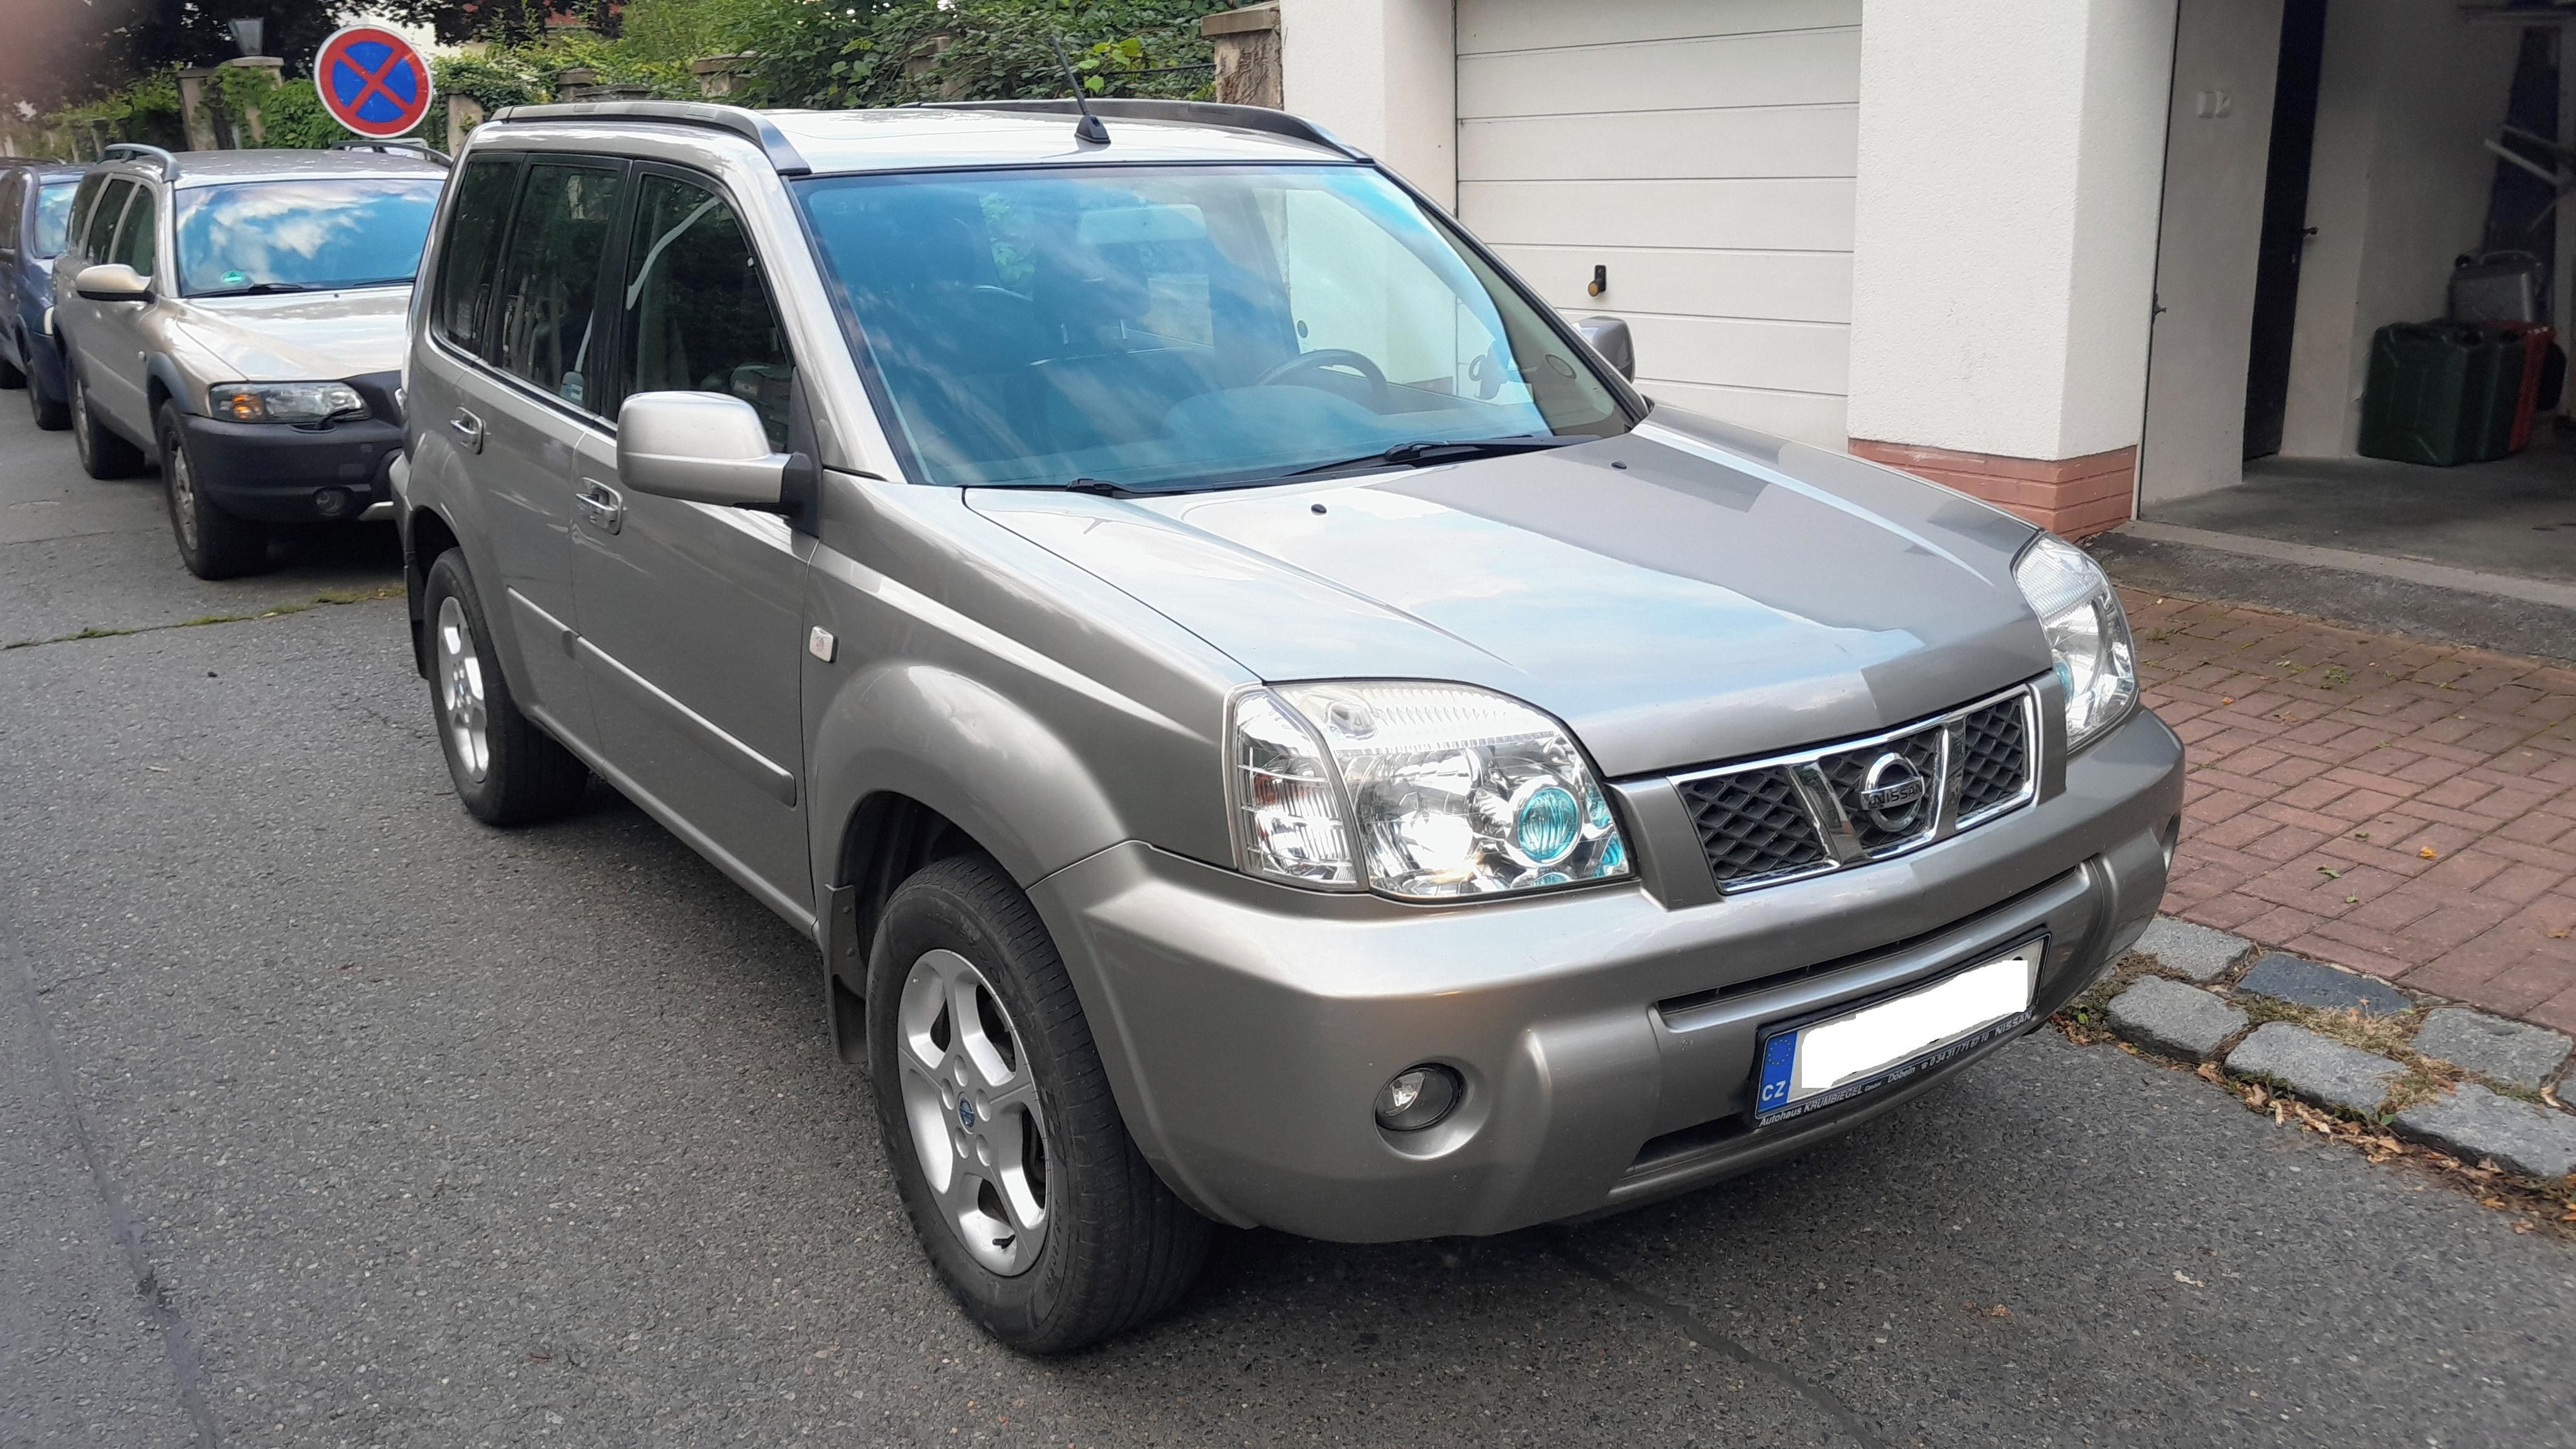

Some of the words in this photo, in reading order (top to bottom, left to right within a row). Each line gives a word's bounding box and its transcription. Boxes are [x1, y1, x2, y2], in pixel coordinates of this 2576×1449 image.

[1874, 784, 1923, 806] NISSAN
[1758, 1108, 1802, 1127] Autohaus
[1804, 1085, 1863, 1113] KRUMBIEGEL
[1994, 1010, 2033, 1037] NISSAN
[1762, 1080, 1786, 1101] CZ
